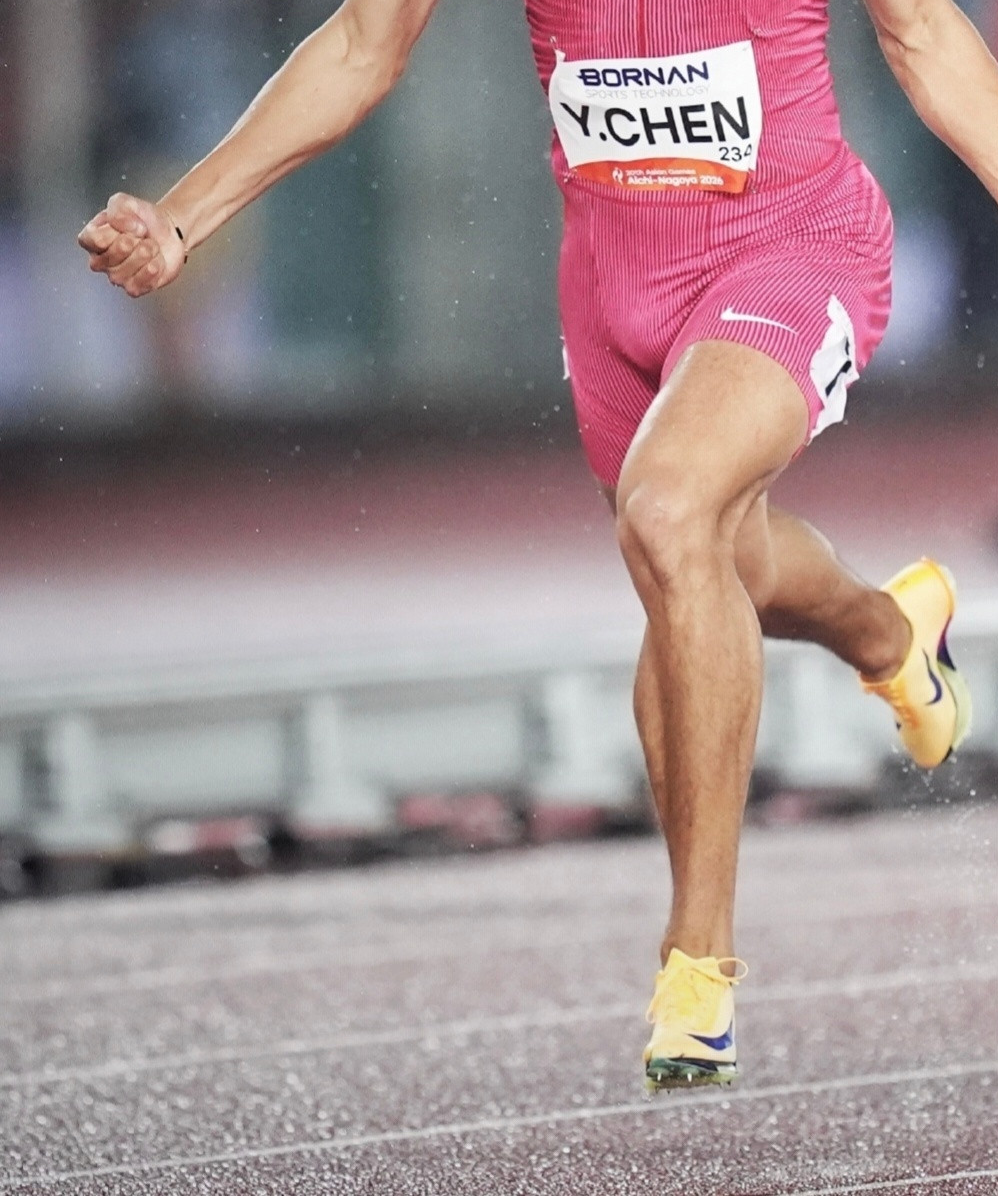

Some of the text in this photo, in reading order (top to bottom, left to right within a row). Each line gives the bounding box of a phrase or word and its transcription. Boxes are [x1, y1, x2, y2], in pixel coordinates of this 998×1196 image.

[577, 61, 710, 87] BORNAN
[585, 85, 710, 100] SPORTS TECHNOLOGY
[560, 96, 750, 146] Y.CHEN
[719, 143, 752, 162] 234
